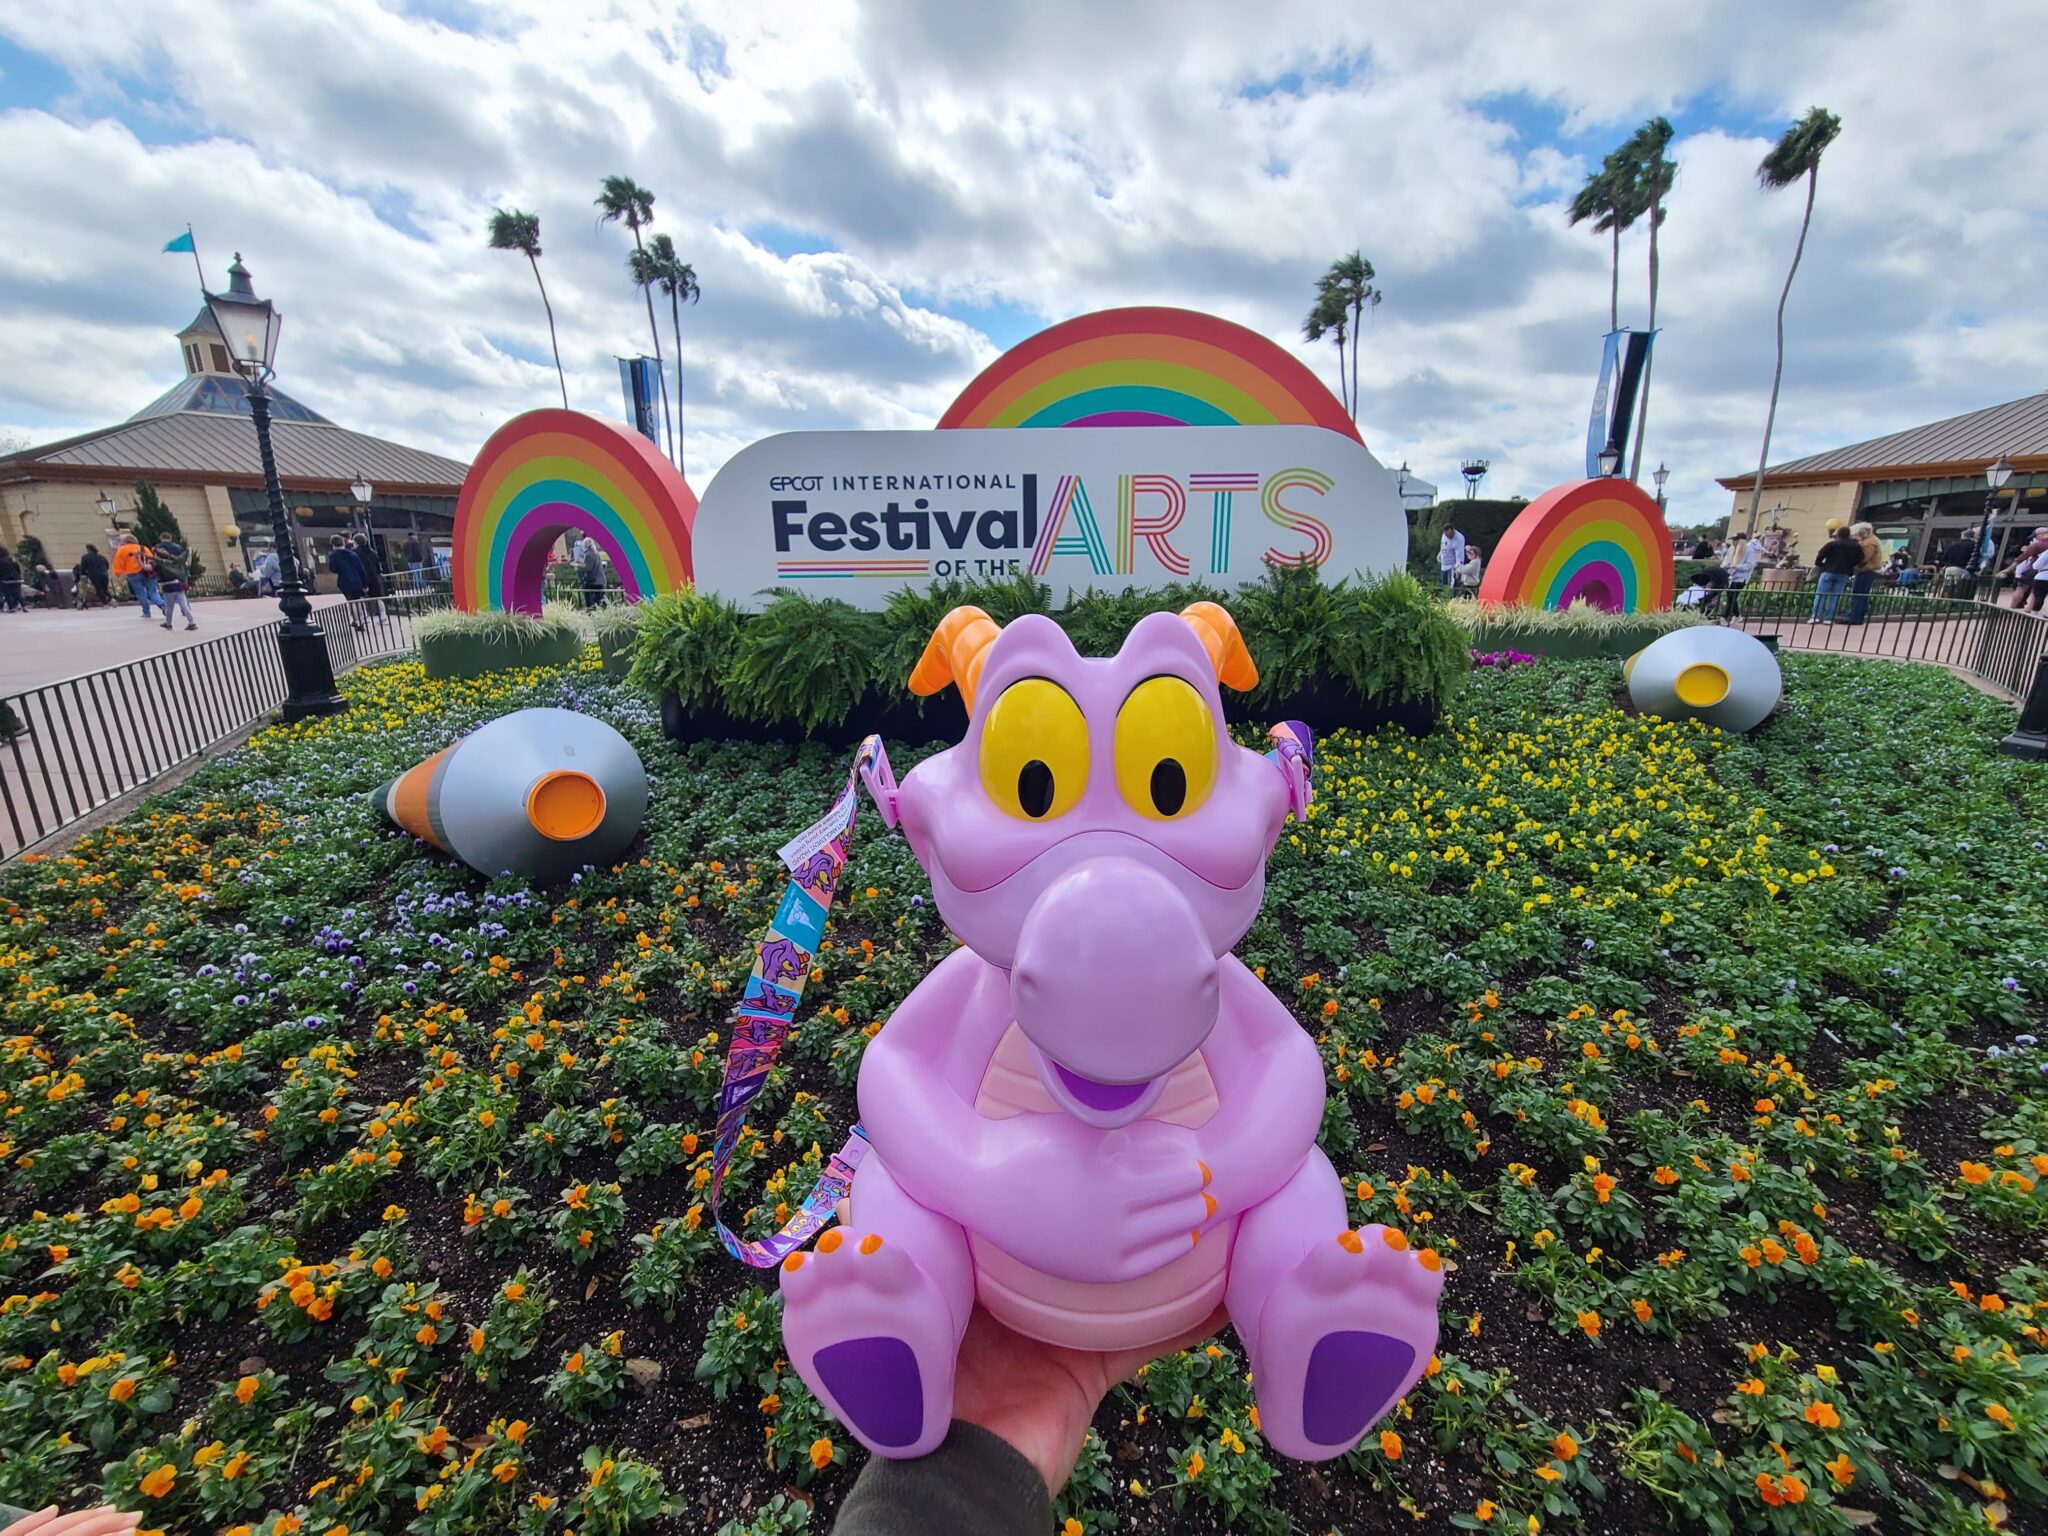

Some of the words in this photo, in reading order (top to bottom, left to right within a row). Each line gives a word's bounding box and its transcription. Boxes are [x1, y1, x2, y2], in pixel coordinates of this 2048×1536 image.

[770, 476, 824, 491] EPCOT
[833, 474, 1016, 491] INTERNATIONAL
[771, 473, 1038, 552] Festival
[1028, 467, 1336, 576] ARTS
[935, 559, 966, 577] OF
[790, 848, 811, 866] HAZARD
